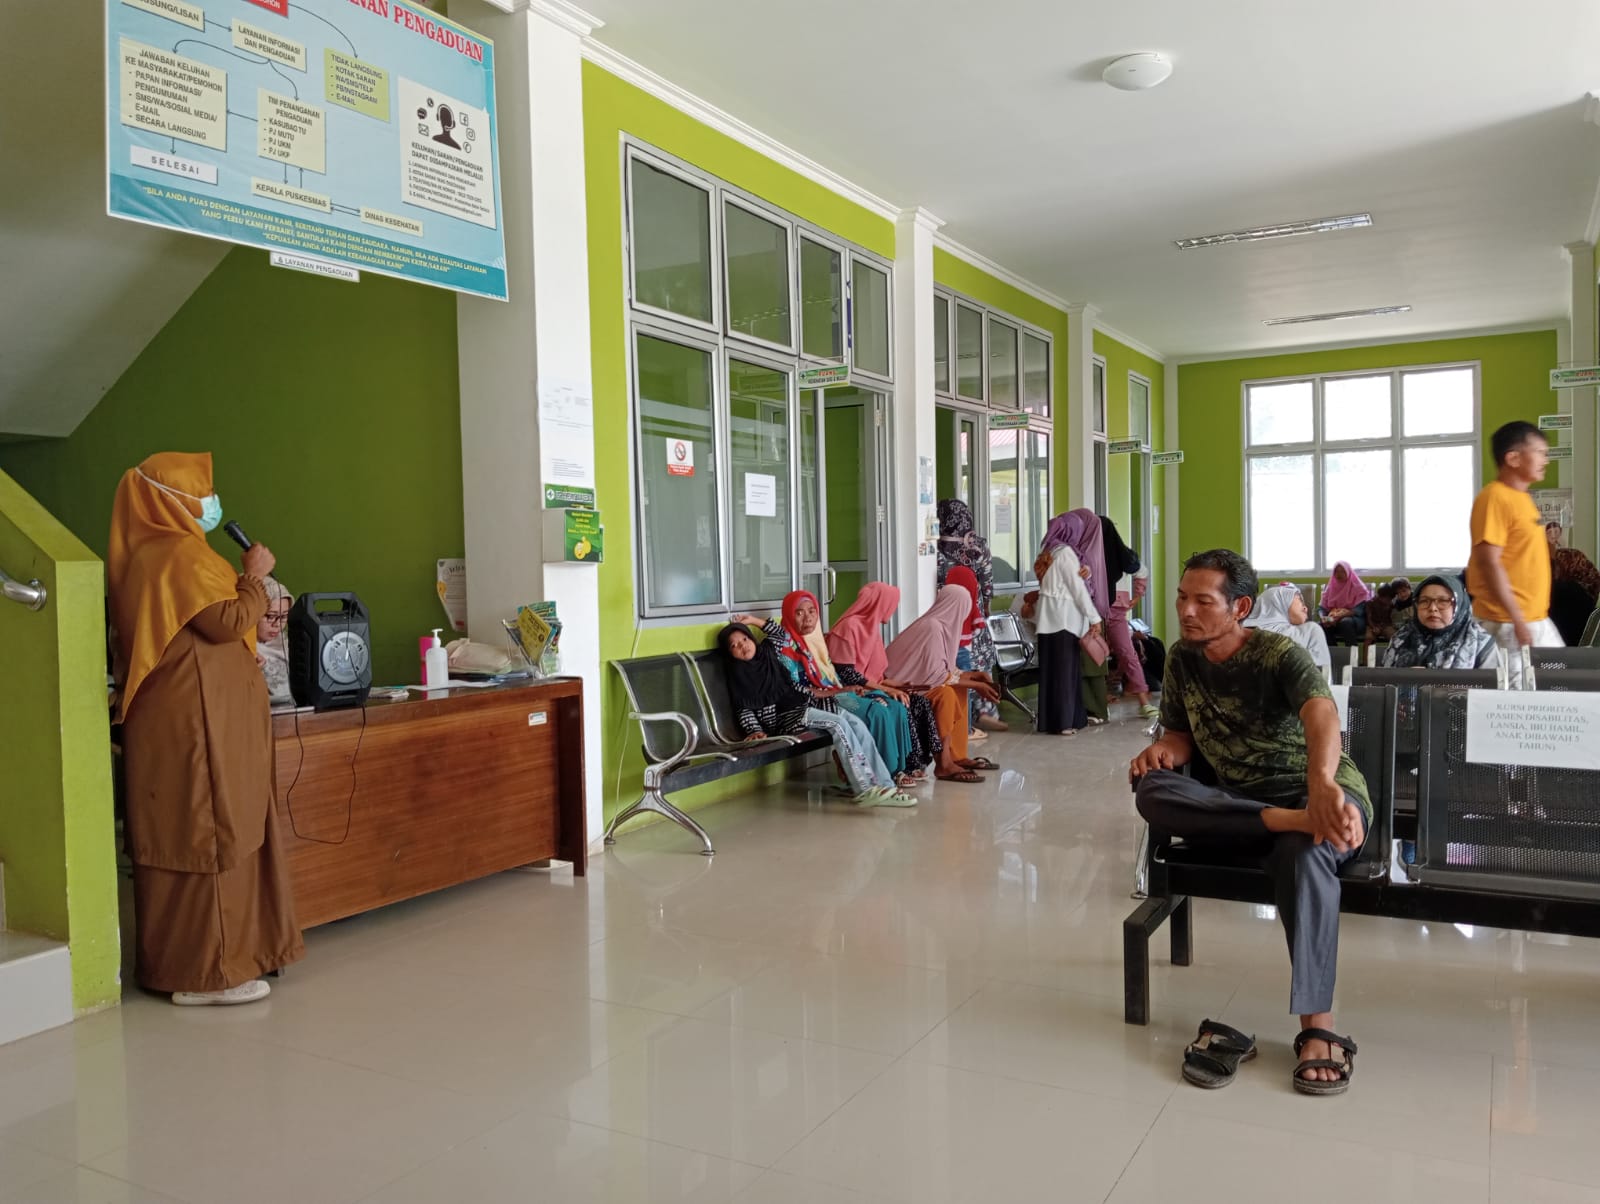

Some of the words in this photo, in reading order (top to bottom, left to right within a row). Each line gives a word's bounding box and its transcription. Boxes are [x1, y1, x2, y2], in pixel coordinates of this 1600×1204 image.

[238, 25, 267, 42] LAYANAN
[268, 37, 300, 55] INFORMASI
[394, 5, 483, 62] PENGADUAN
[244, 38, 257, 48] DAN
[258, 43, 296, 63] PENGADUAN
[124, 55, 138, 66] KE
[138, 59, 223, 92] MASYARAKAT/PEMOHON
[139, 49, 175, 67] JAWABAN
[177, 61, 210, 78] KELUHAN
[331, 54, 350, 66] TIDAK
[350, 62, 382, 79] LANGSUNG
[135, 70, 160, 84] PAPAN
[335, 66, 355, 78] KOTAK
[355, 73, 376, 86] SARAN
[135, 81, 188, 103] PENGUMUMAN
[336, 93, 357, 106] E-MAIL
[135, 92, 193, 116] SMS/WA/SOSIAL
[194, 109, 218, 122] MEDIA/
[135, 103, 161, 116] E-MAIL
[268, 96, 279, 105] TIM
[280, 100, 320, 119] PENANGANAN
[276, 109, 313, 126] PENGADUAN
[135, 114, 166, 129] SECARA
[168, 123, 207, 140] LANGSUNG
[269, 118, 298, 132] KASUBAG
[256, 183, 284, 196] KEPALA
[285, 190, 327, 207] PUSKESMAS
[165, 191, 187, 202] ANDA
[189, 196, 208, 207] PUAS
[210, 201, 239, 214] DENGAN
[242, 207, 273, 221] LAYANAN
[200, 209, 221, 219] YANG
[365, 211, 384, 223] DINAS
[385, 216, 420, 232] KESEHATAN
[284, 257, 314, 269] LAYANAN
[315, 264, 353, 278] PENGADUAN
[1486, 711, 1522, 721] (PASIEN
[1525, 713, 1589, 725] DISABILITAS,
[1496, 703, 1525, 711] KURSI
[1527, 704, 1578, 713] PRIORITAS
[1490, 722, 1527, 730] LANSIA,
[1530, 722, 1547, 731] IBU
[1549, 724, 1584, 733] HAMIL,
[1495, 731, 1521, 740] ANAK
[1524, 732, 1572, 742] DIBAWAH
[1518, 742, 1556, 752] TAHUN)
